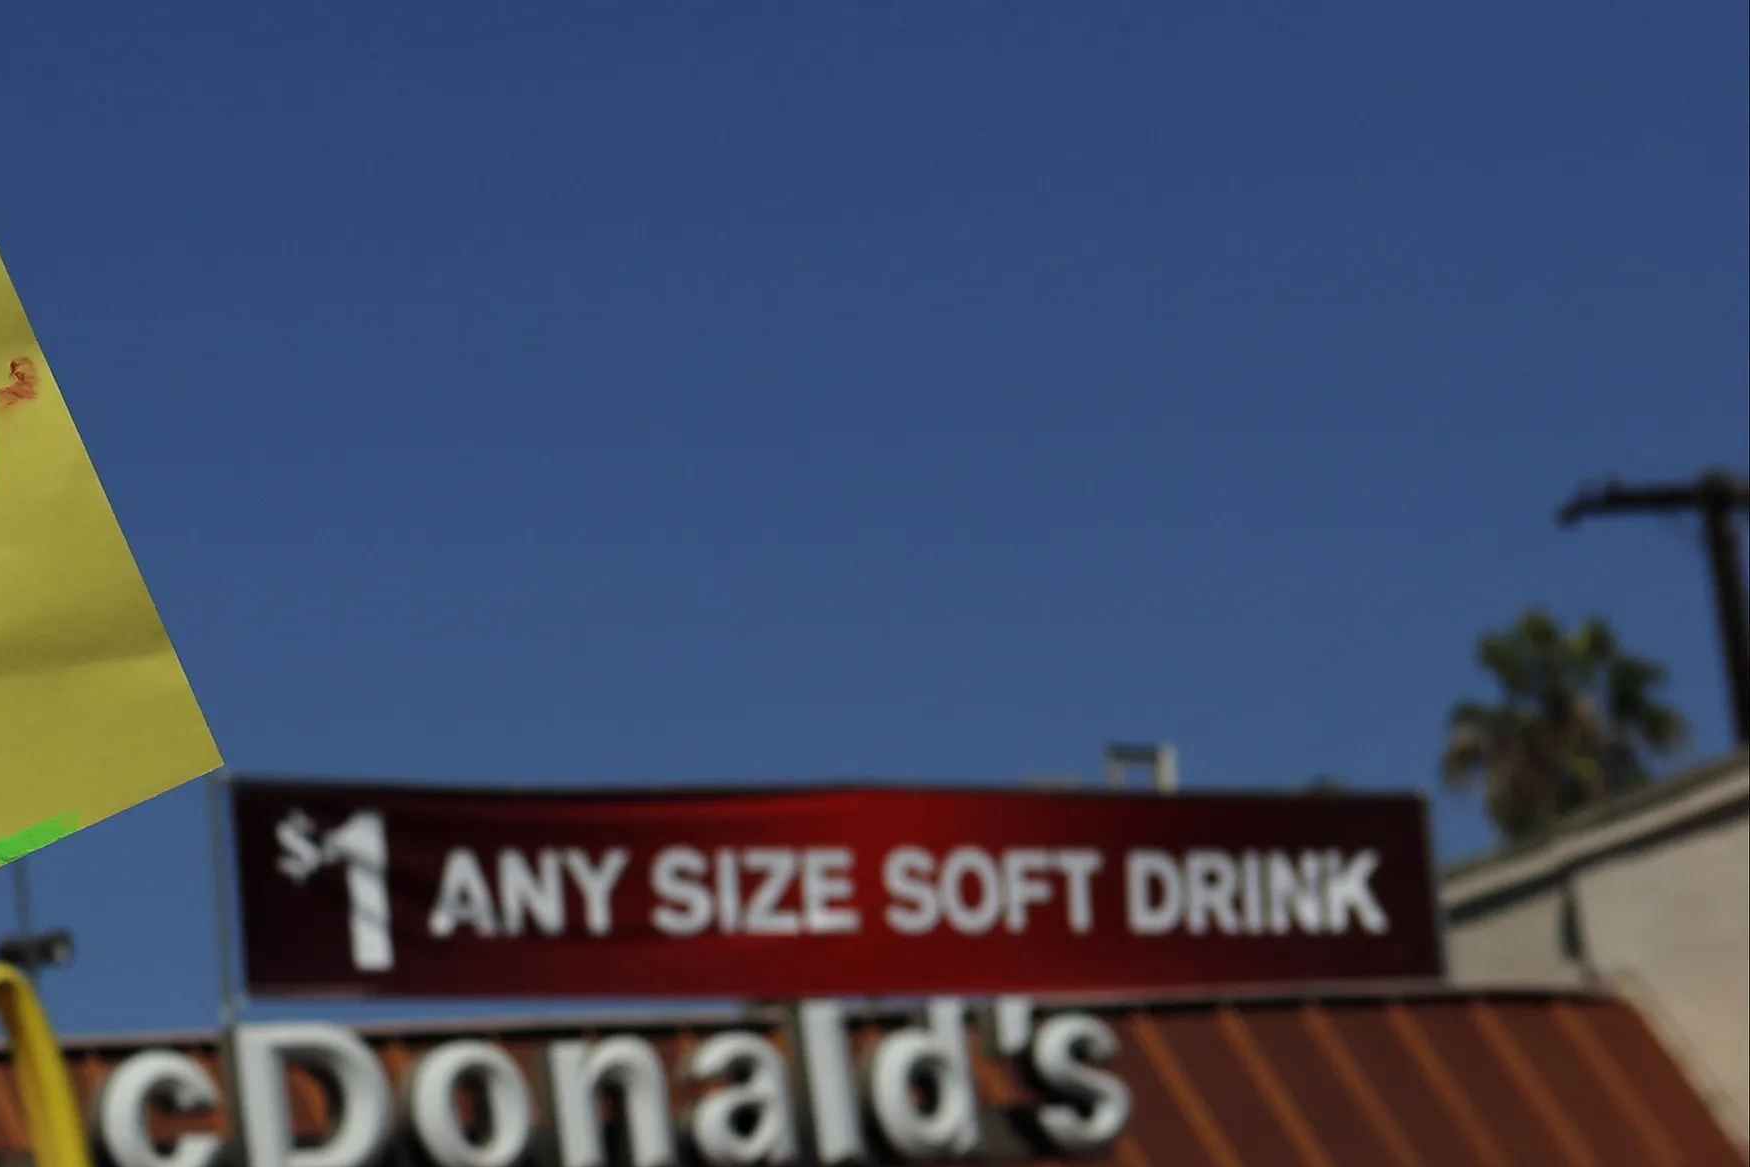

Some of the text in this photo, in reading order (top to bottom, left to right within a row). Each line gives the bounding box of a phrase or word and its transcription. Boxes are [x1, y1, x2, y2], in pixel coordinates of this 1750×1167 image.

[275, 809, 1388, 972] $1 ANY SIZE SOFT DRINK
